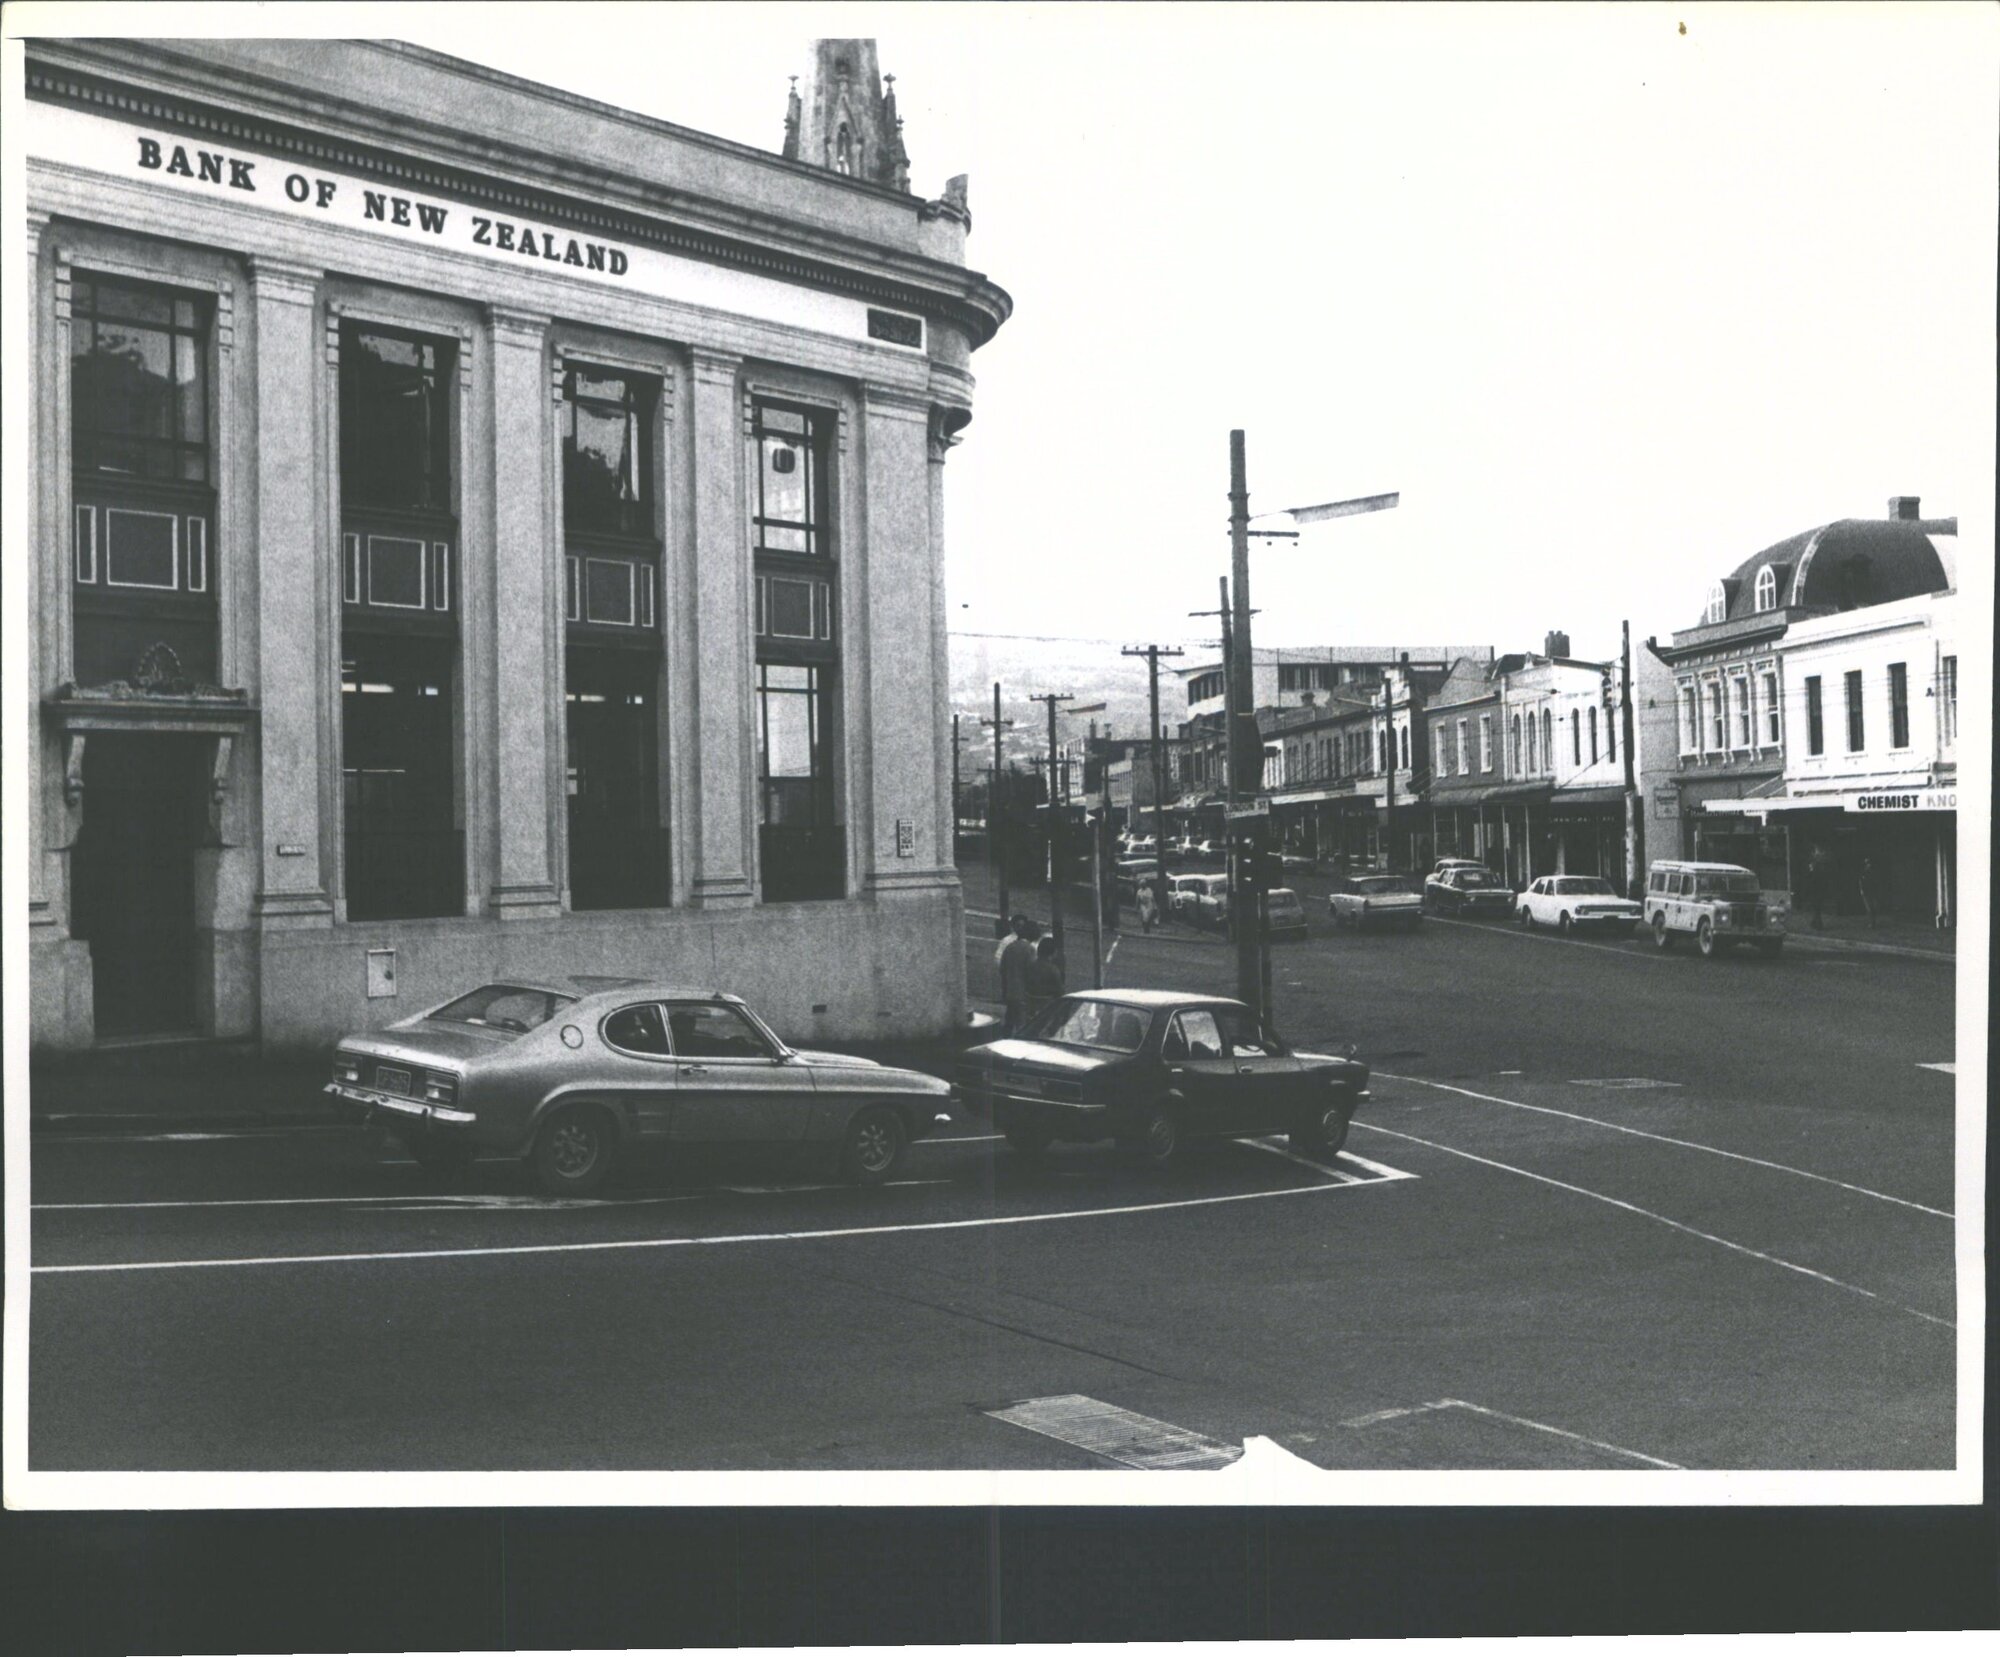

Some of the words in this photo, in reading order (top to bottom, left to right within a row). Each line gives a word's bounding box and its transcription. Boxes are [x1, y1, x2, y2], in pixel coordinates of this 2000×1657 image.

[138, 137, 256, 192] BANK
[285, 174, 337, 208] OF
[363, 190, 448, 234] NEW
[472, 216, 628, 277] ZEALAND
[1857, 795, 1919, 809] CHEMIST
